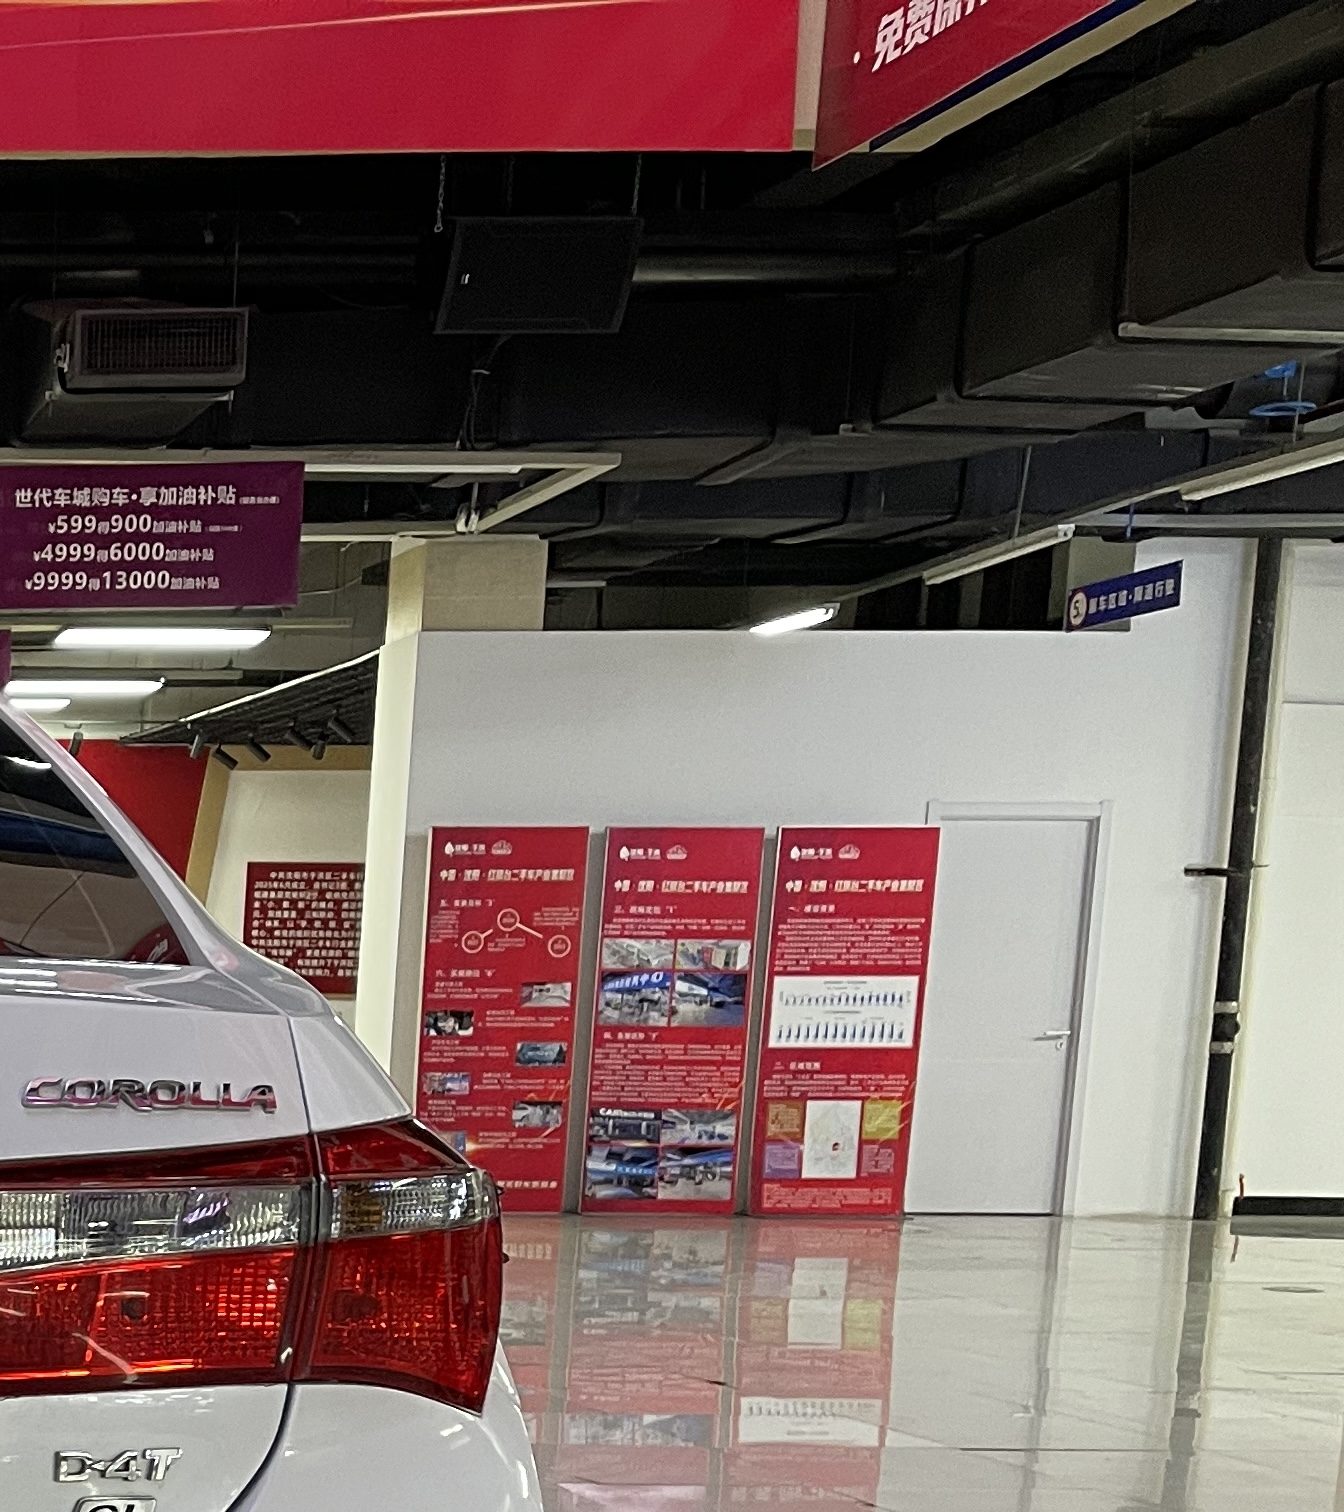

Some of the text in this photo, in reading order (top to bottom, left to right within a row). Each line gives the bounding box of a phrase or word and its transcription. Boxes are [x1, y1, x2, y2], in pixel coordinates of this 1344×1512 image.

[871, 0, 989, 73] 免费保
[21, 1076, 277, 1114] COROLLA
[54, 1447, 184, 1482] D-4T
